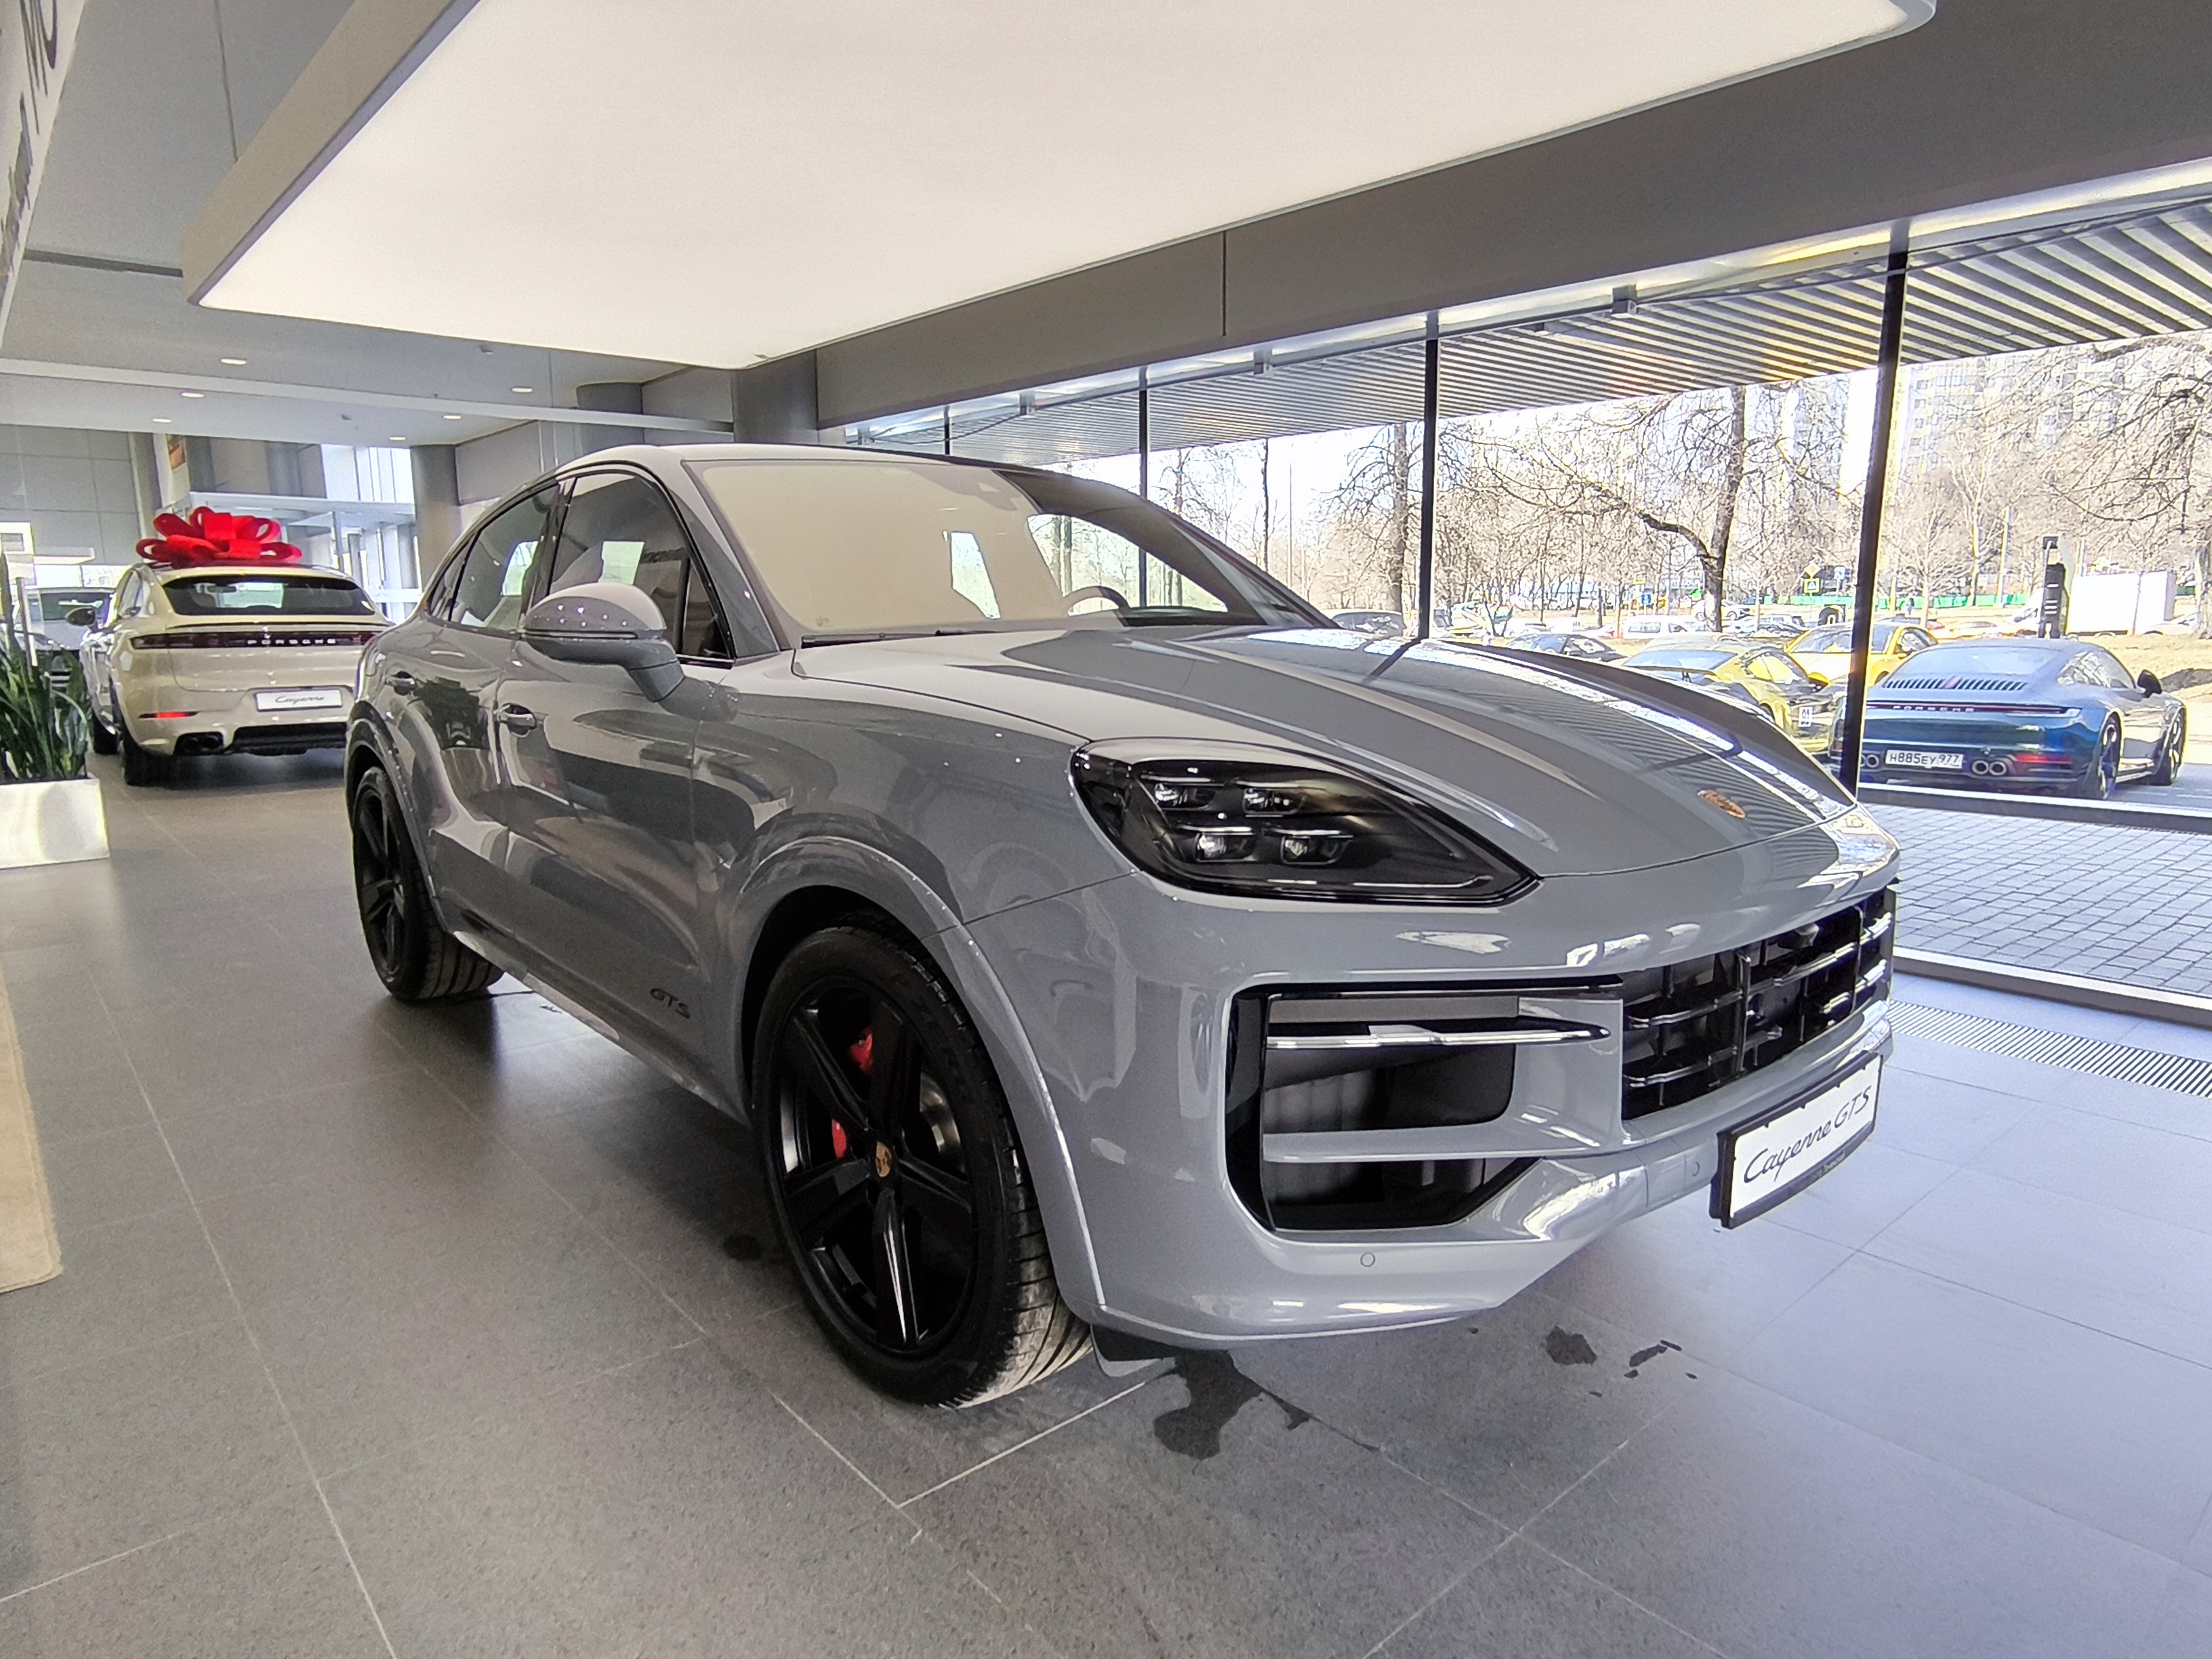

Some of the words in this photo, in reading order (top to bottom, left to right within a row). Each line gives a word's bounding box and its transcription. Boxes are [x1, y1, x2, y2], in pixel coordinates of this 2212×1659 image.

[275, 695, 325, 705] Cayenne
[650, 988, 691, 1019] GTS
[1744, 1120, 1831, 1183] Cayenne
[1834, 1085, 1872, 1128] GTS
